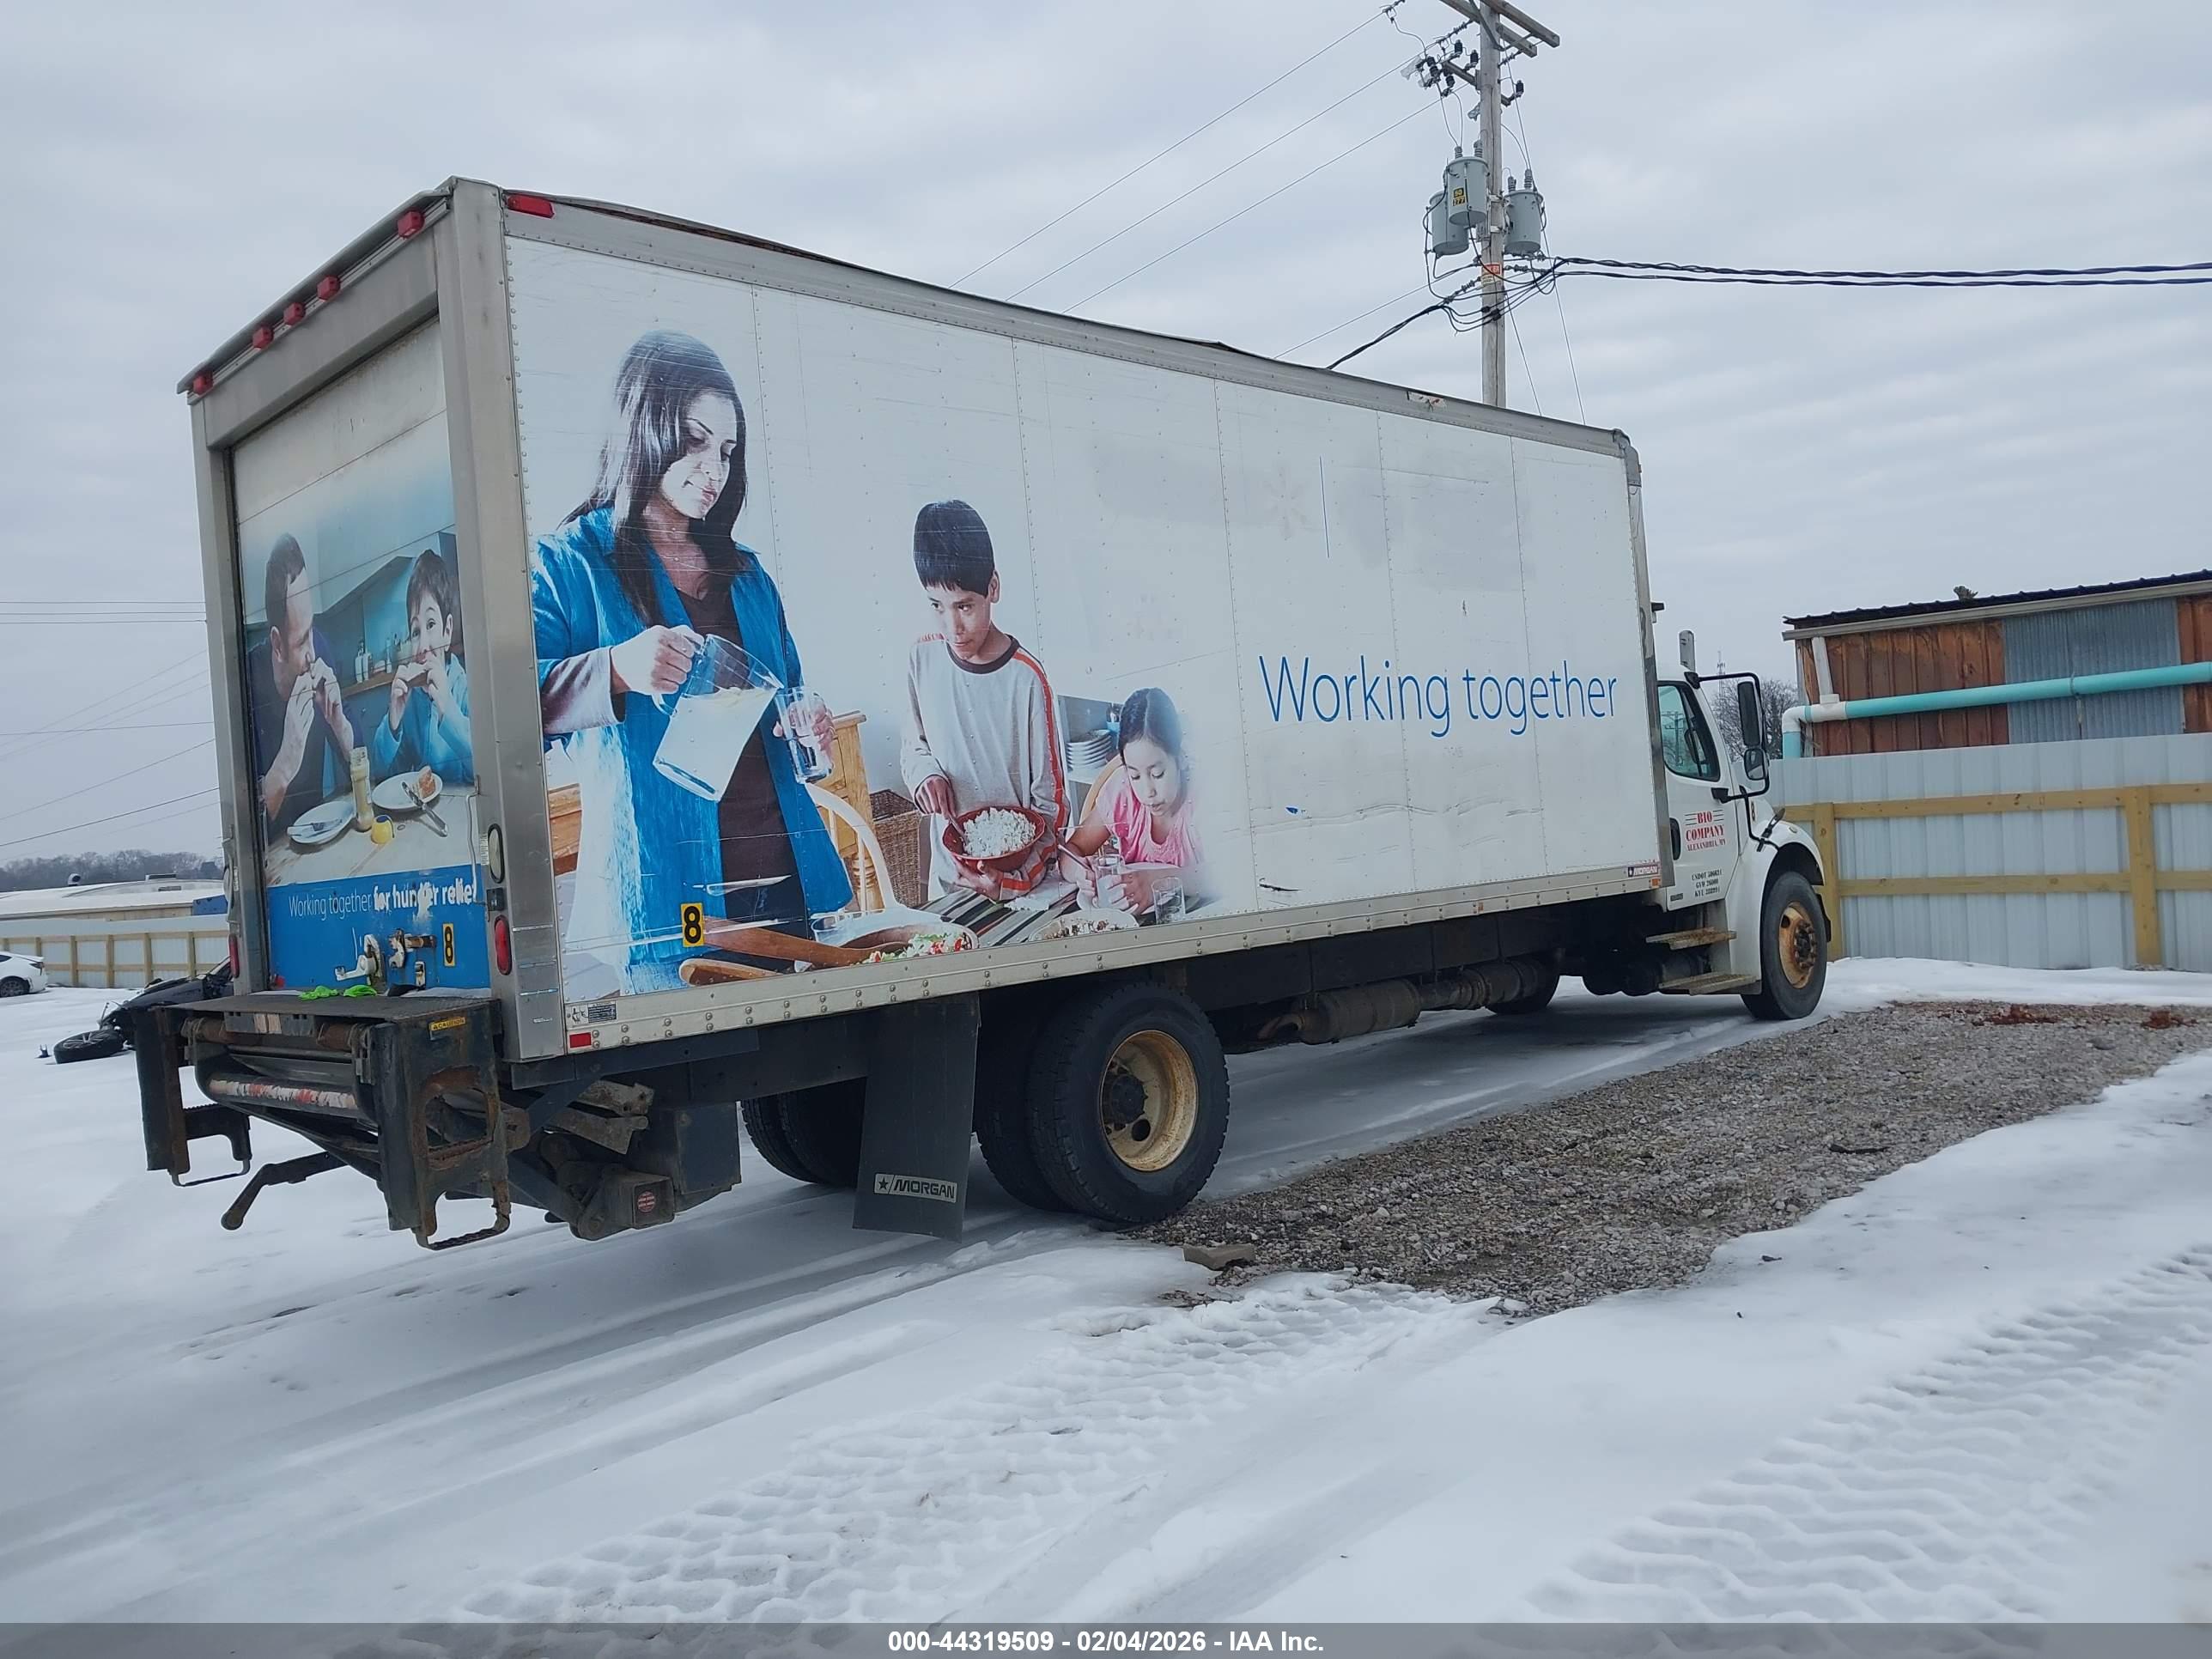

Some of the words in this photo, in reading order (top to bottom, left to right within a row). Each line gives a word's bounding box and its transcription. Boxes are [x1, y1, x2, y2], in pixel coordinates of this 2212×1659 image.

[1259, 655, 1450, 738] Working
[1462, 660, 1617, 735] together
[1686, 824, 1723, 842] COMPANY
[1697, 811, 1712, 823] BIO
[289, 896, 326, 921] Working
[328, 889, 371, 919] together
[374, 886, 391, 911] for
[684, 905, 702, 944] 8
[445, 926, 453, 963] 8
[893, 1179, 955, 1199] MORGAN
